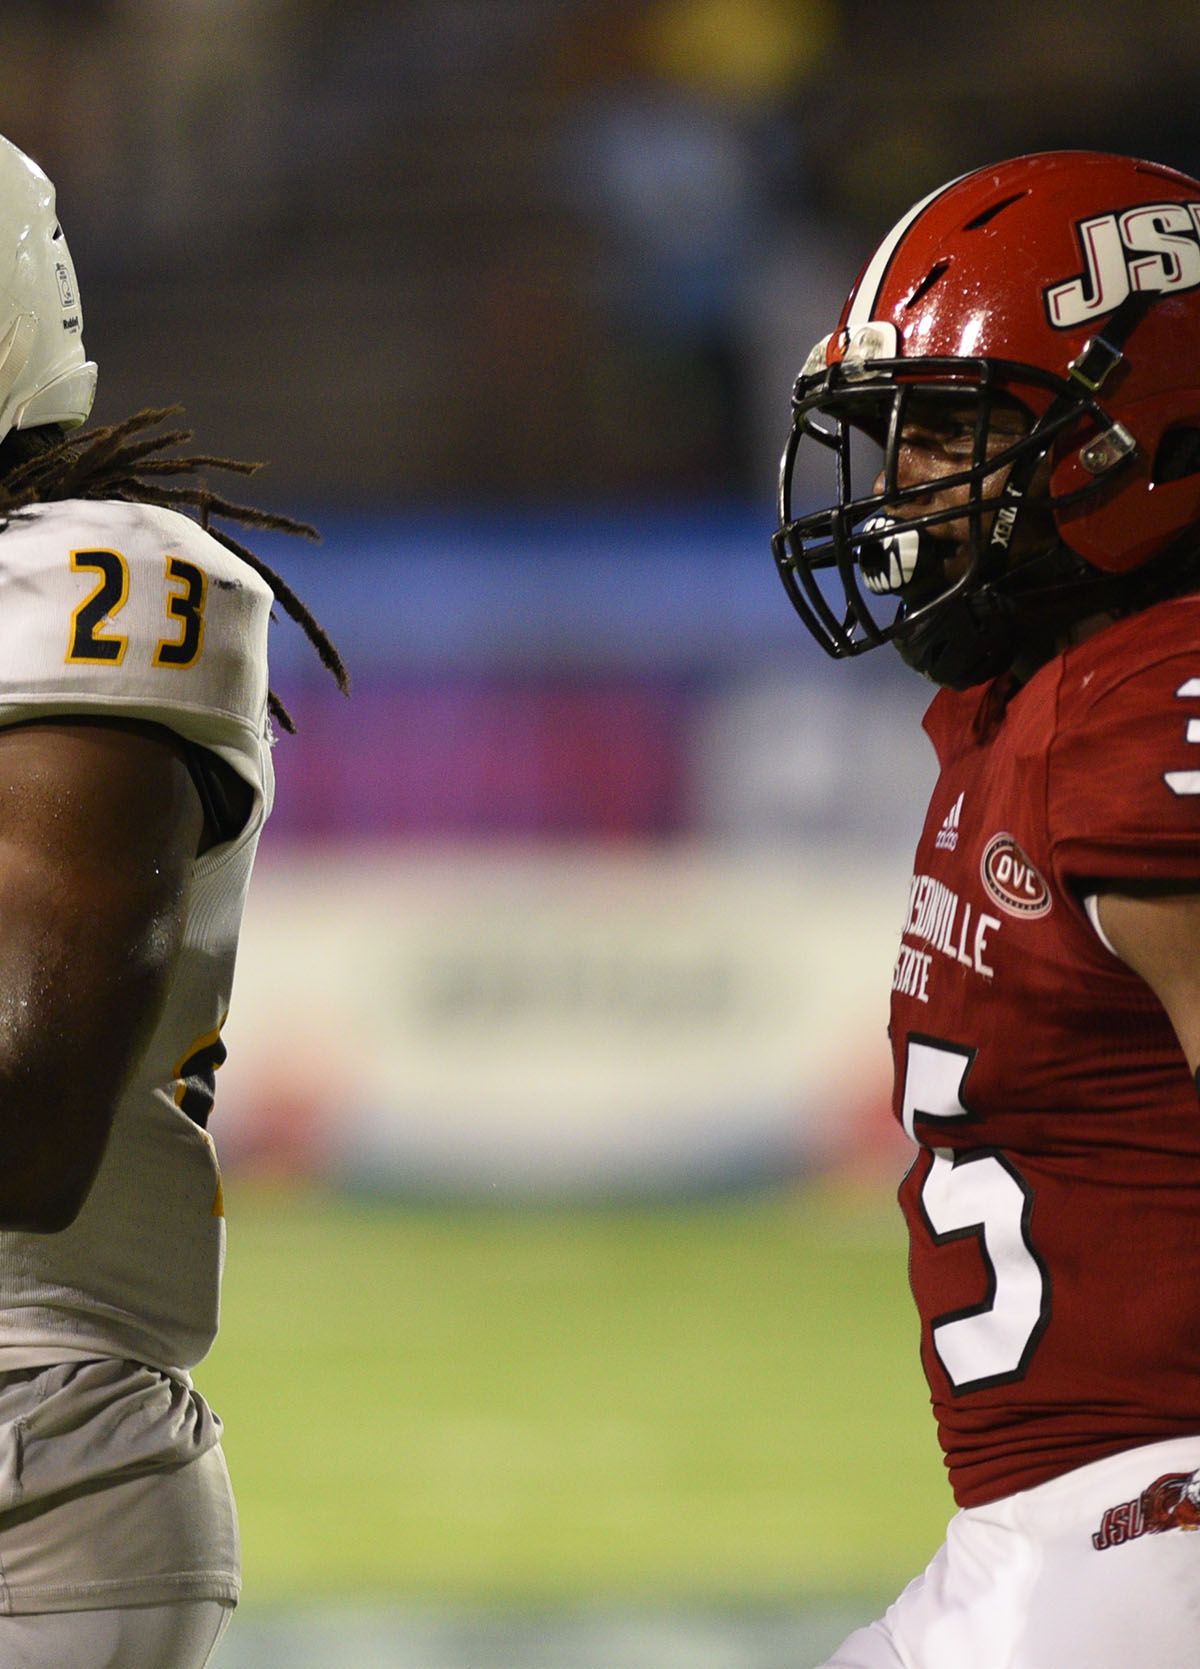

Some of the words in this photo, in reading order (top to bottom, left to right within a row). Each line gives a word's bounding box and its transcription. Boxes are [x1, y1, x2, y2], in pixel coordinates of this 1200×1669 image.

[1043, 202, 1200, 332] JS
[64, 547, 208, 670] 23
[893, 943, 933, 1003] STATE
[1091, 1497, 1146, 1551] JSU
